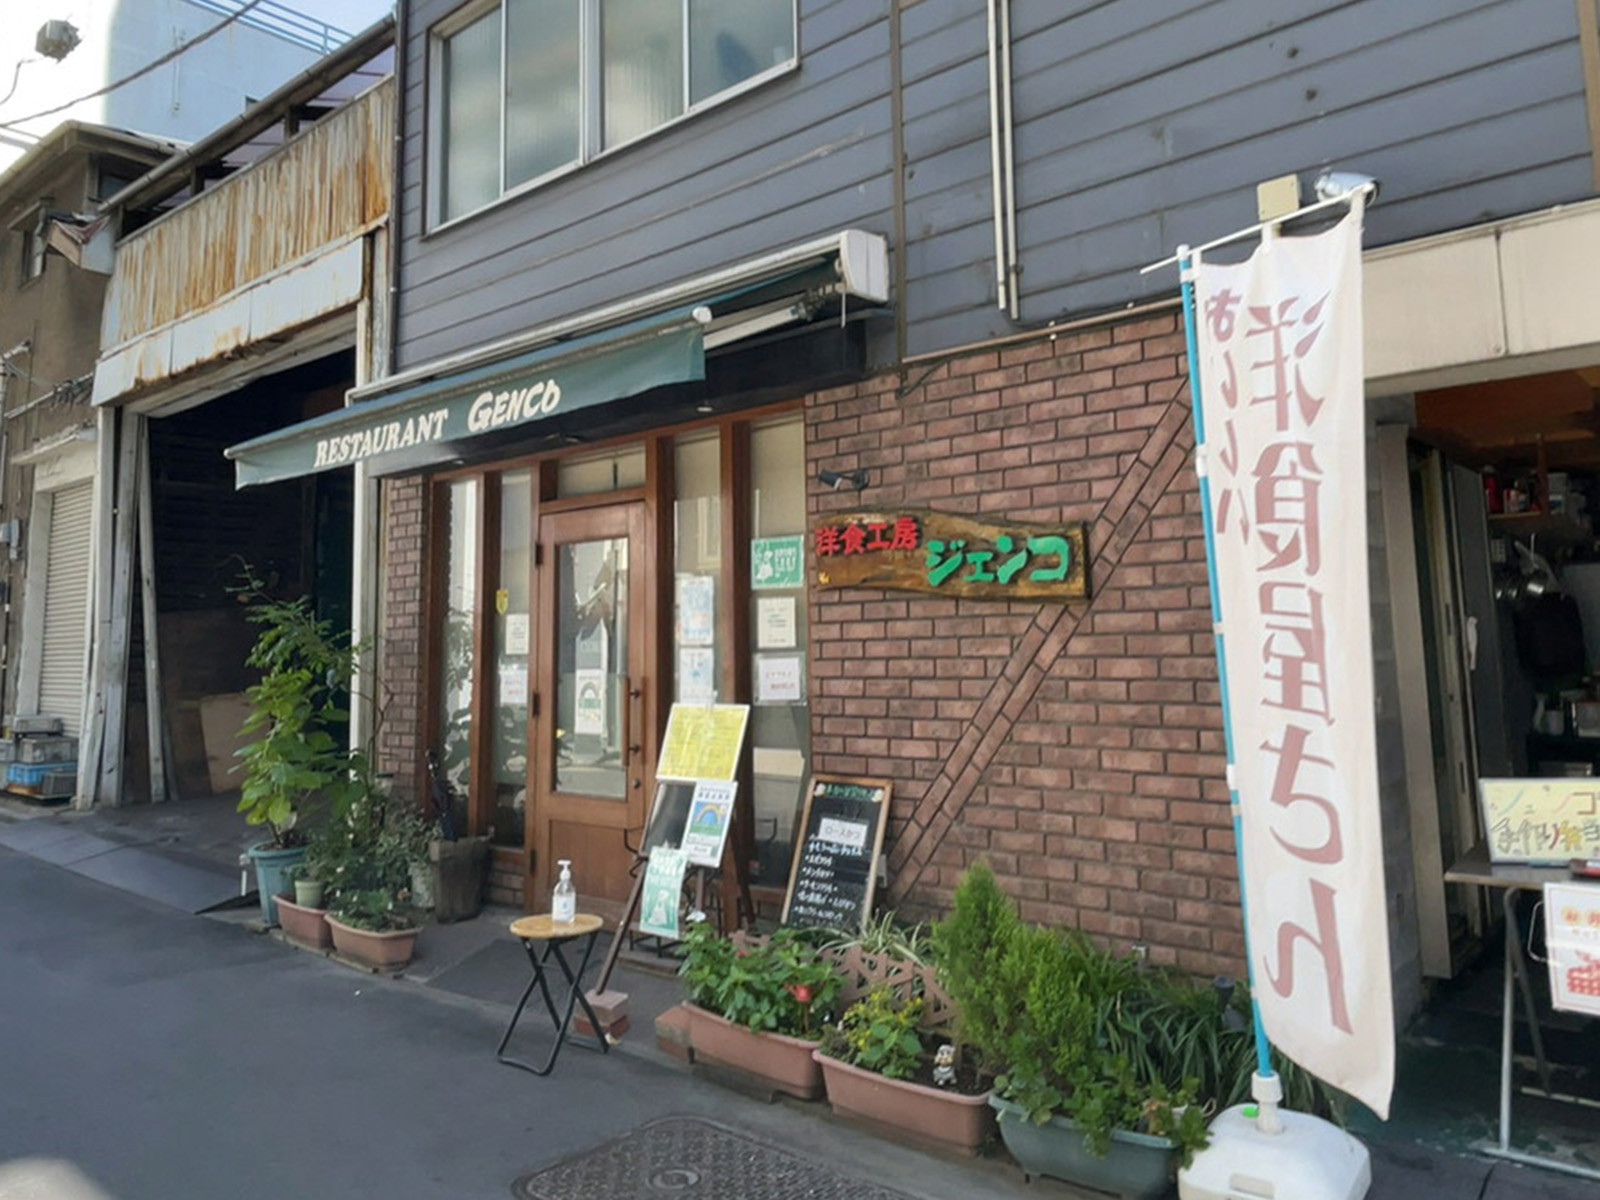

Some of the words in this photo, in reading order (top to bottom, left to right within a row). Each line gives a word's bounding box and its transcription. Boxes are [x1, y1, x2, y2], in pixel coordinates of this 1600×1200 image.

[314, 409, 448, 468] RESTAURANT
[467, 379, 562, 432] GENCO
[815, 516, 918, 557] 洋食工房
[926, 534, 1069, 587] ジェンコ
